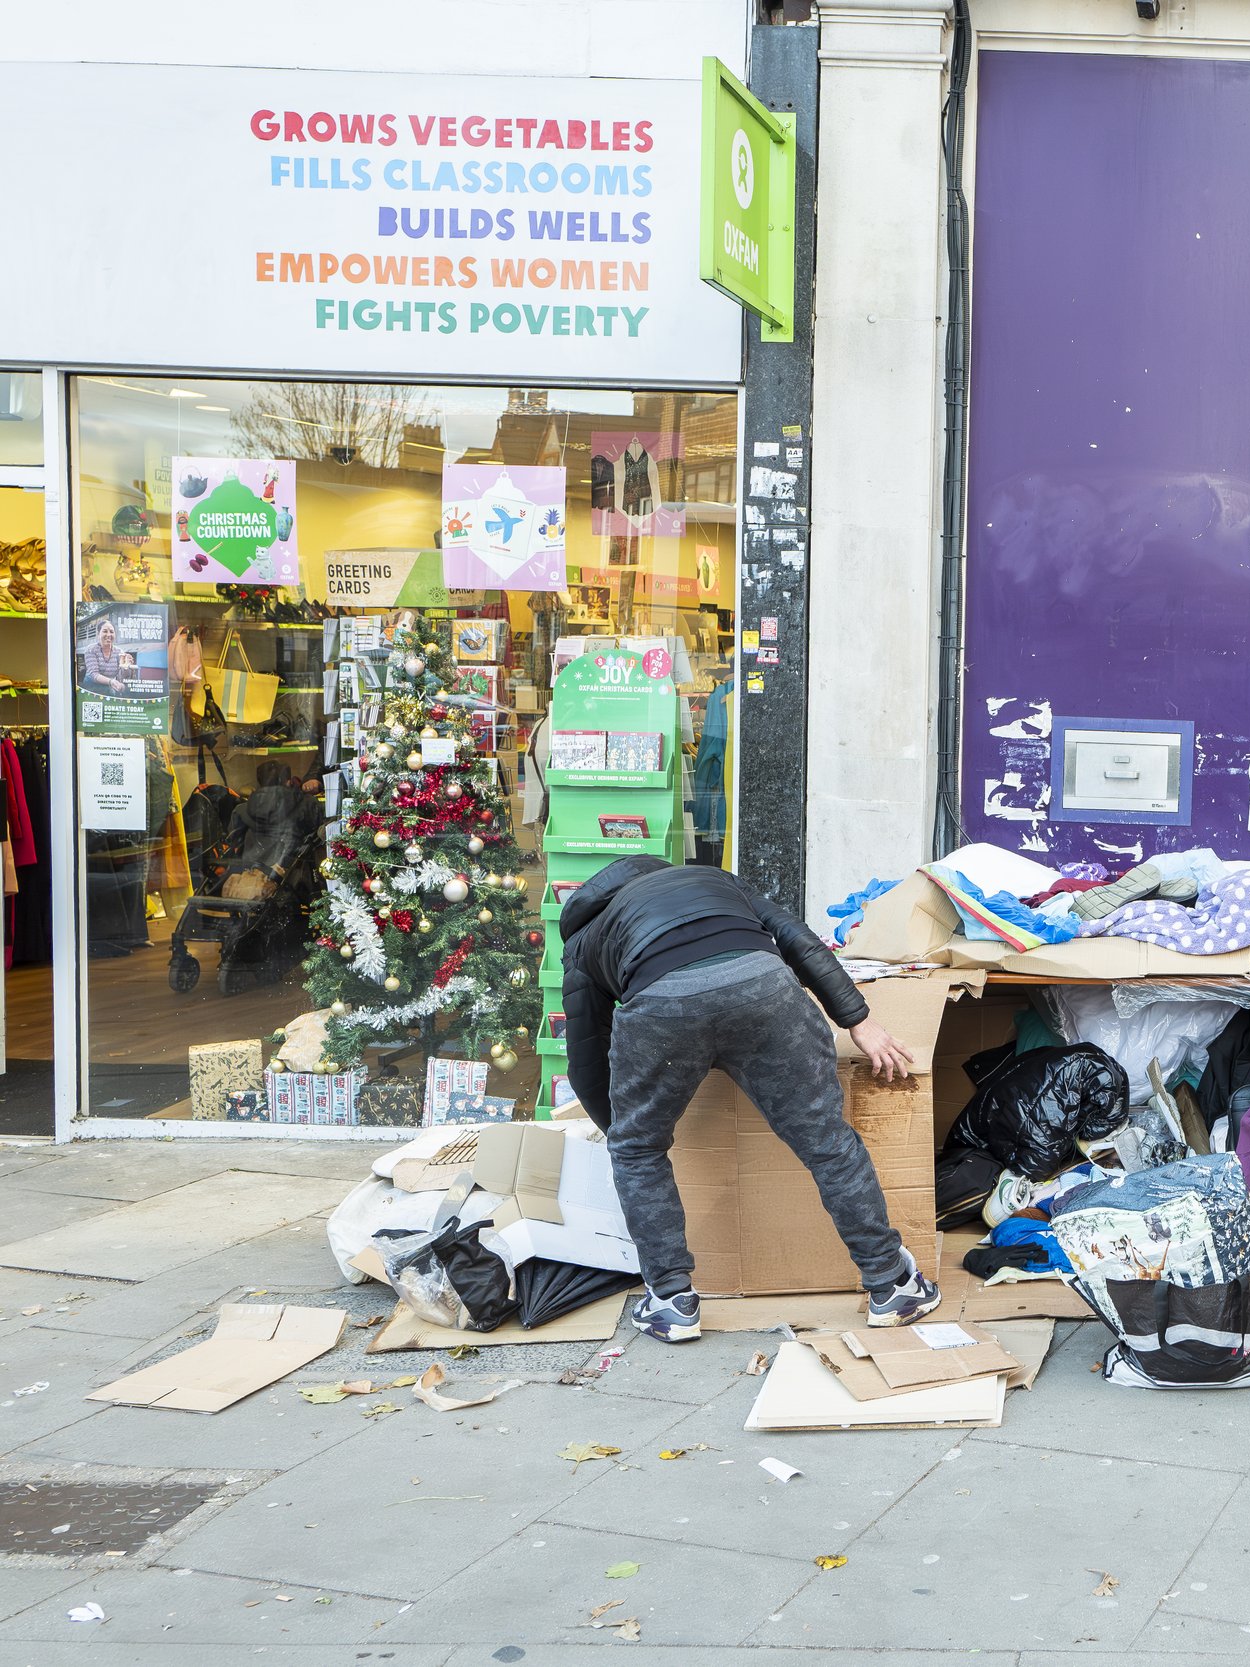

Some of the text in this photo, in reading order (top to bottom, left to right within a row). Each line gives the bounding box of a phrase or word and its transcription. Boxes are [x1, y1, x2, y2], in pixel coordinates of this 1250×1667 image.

[250, 109, 653, 153] GROWS VEGETABLES
[271, 155, 653, 197] FILLS CLASSROOMS
[378, 206, 651, 244] BUILDS WELLS
[724, 220, 758, 276] OXFAM
[255, 252, 649, 291] EMPOWERS WOMEN
[315, 299, 648, 337] FIGHTS POVERTY
[200, 512, 267, 525] CHRISTMAS
[196, 526, 271, 538] COUNTDOWN
[328, 564, 391, 578] GREETING
[329, 580, 371, 594] CARDS
[120, 629, 162, 640] THE WAY
[656, 650, 664, 660] 3
[650, 660, 662, 668] FOR
[599, 666, 633, 684] JOY
